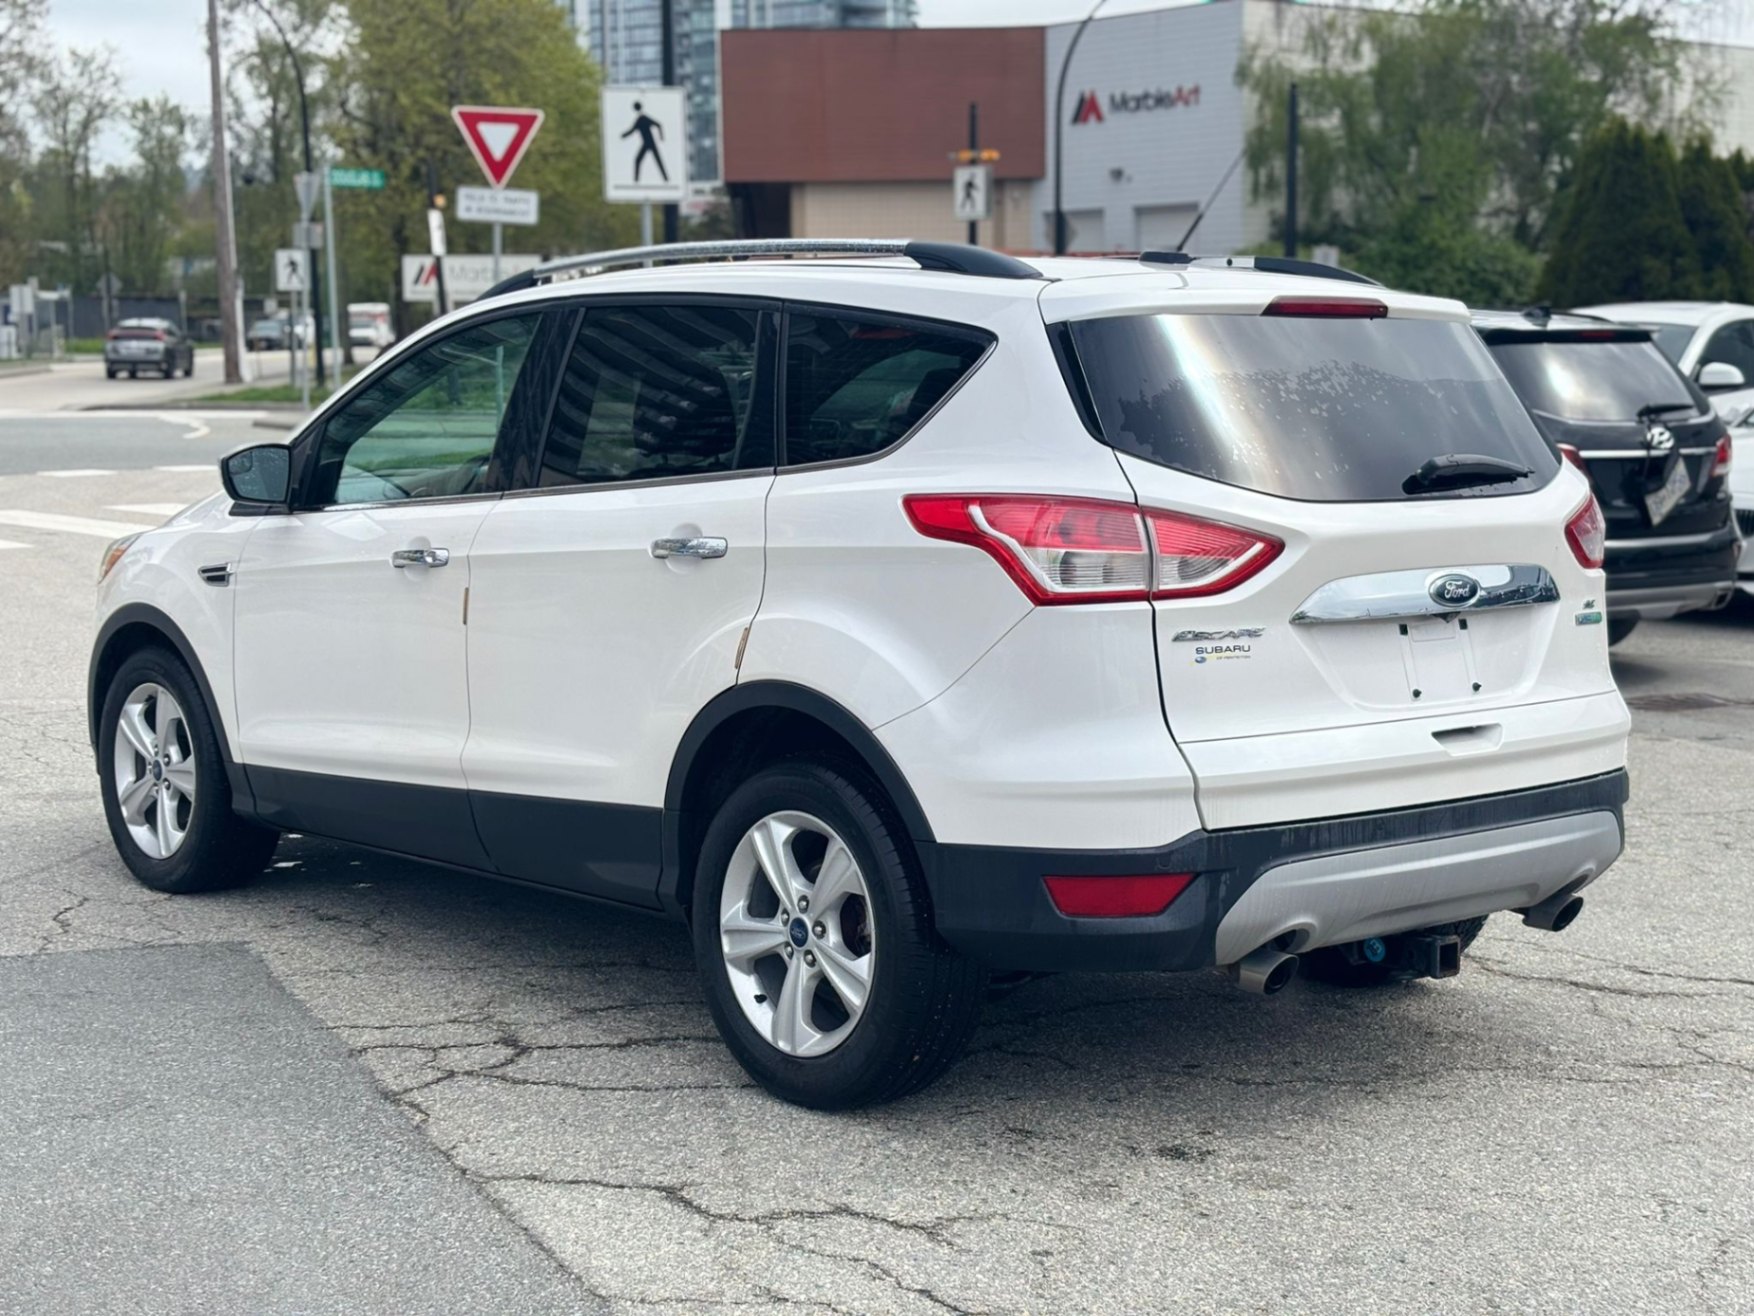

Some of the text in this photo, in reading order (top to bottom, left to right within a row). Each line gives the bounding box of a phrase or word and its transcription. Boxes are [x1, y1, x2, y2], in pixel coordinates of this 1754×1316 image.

[1109, 85, 1200, 113] MarbleArt
[1444, 580, 1470, 599] Ford
[1172, 627, 1266, 642] ESCAPE
[1195, 645, 1251, 655] SUBARU
